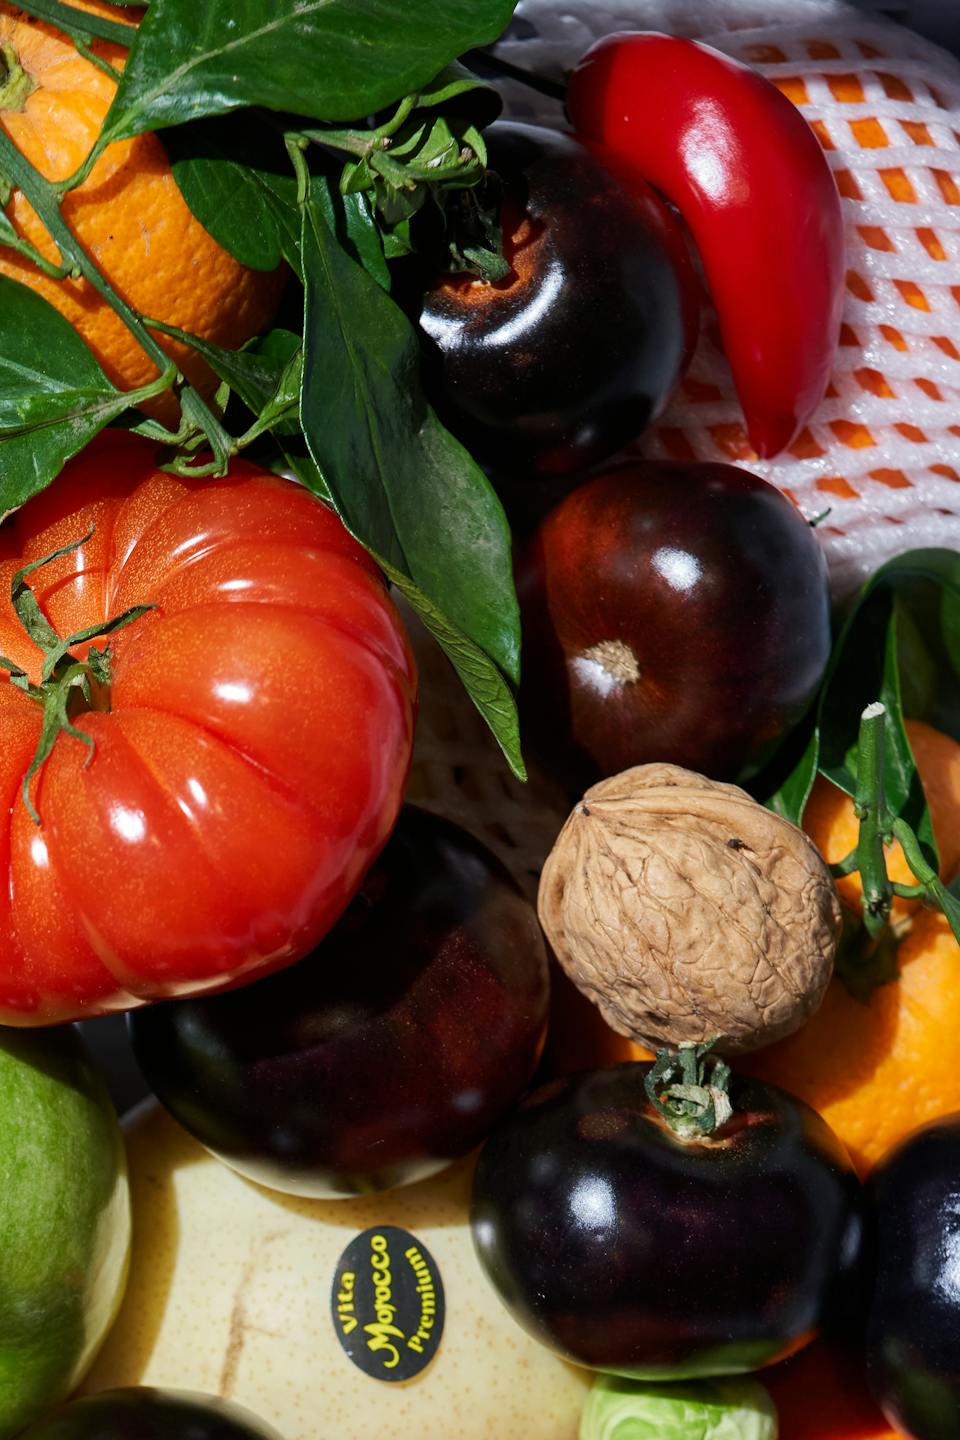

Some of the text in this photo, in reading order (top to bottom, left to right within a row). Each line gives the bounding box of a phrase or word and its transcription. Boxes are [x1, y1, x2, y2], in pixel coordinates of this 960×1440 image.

[337, 1272, 358, 1335] Vita
[363, 1235, 405, 1368] Morocco
[405, 1246, 435, 1353] Premium
